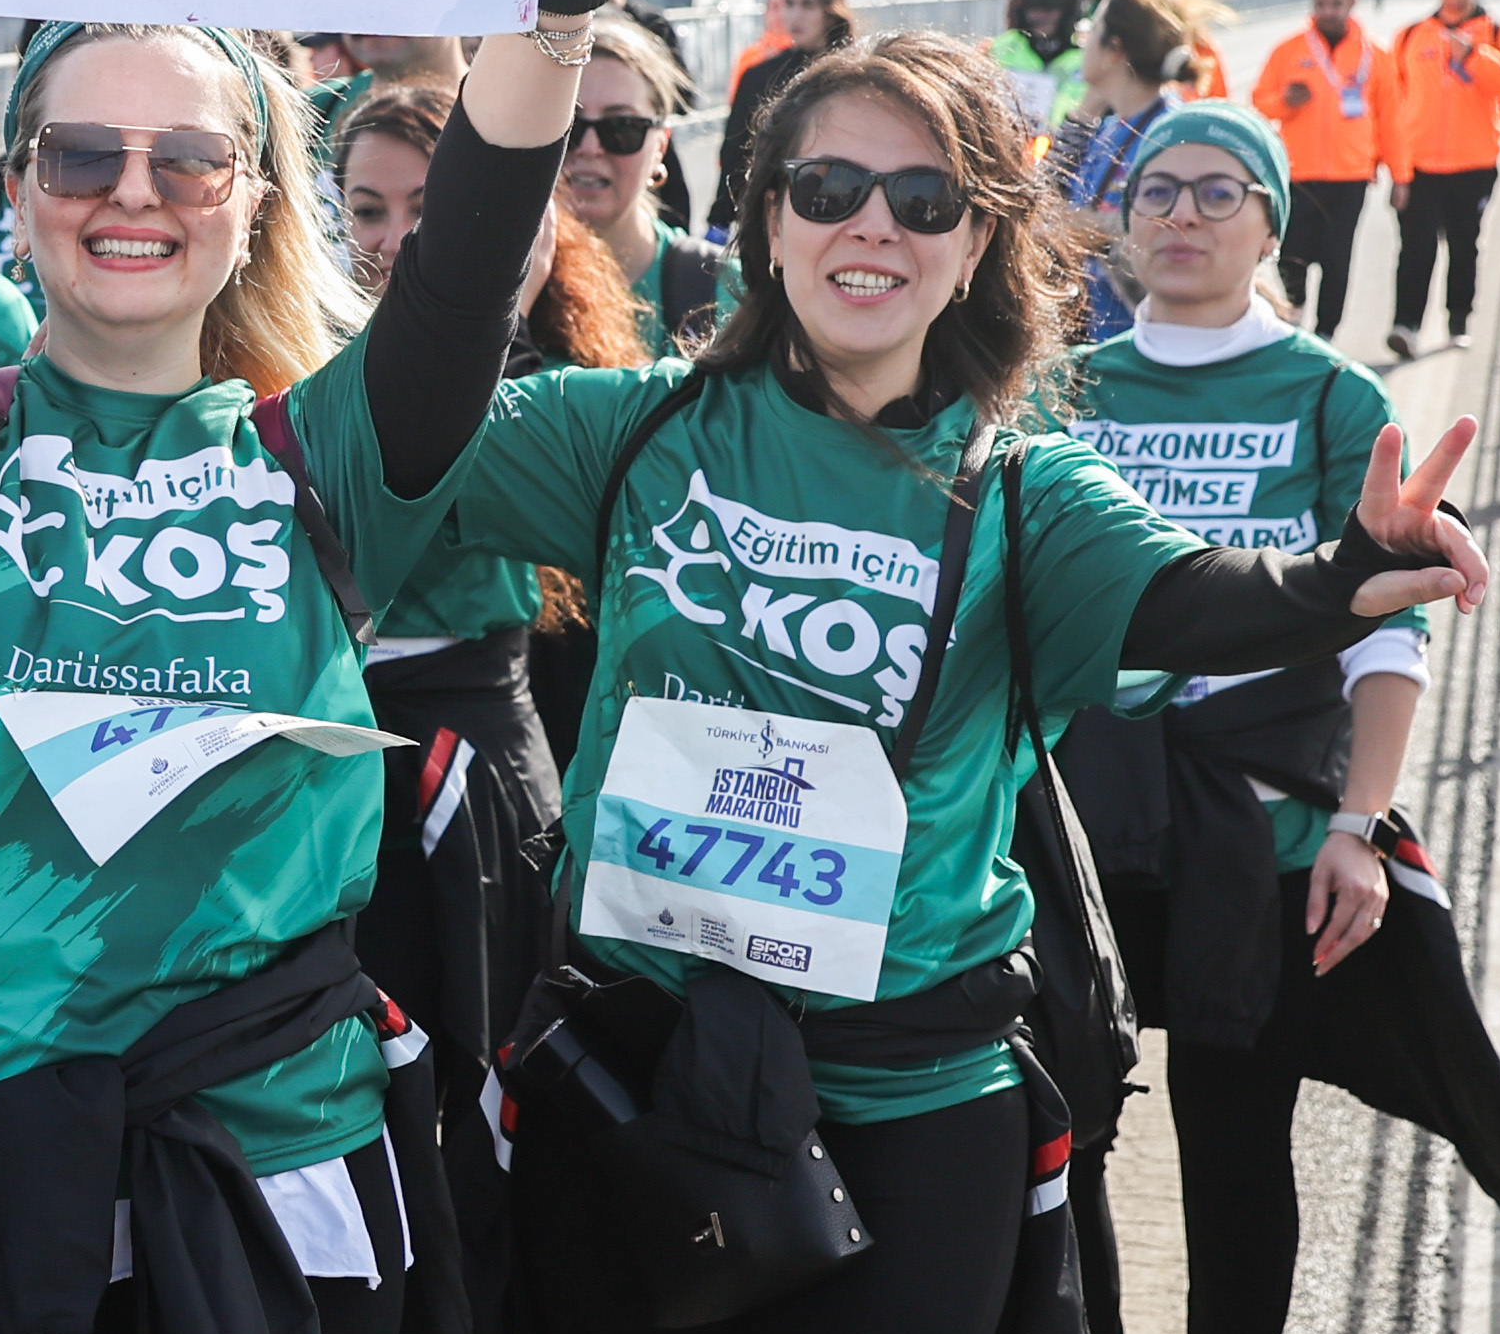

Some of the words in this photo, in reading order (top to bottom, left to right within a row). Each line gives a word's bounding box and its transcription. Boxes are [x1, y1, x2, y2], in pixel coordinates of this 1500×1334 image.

[1136, 431, 1285, 460] KONUSU
[164, 461, 236, 506] için
[729, 515, 839, 567] Eğitim
[851, 542, 921, 588] için
[84, 518, 290, 623] KOŞ
[706, 726, 758, 743] TÜRKİYE
[776, 737, 830, 754] BANKASI
[711, 767, 803, 806] İSTANBUL
[705, 793, 802, 829] MARATONU
[636, 818, 847, 906] 47743
[750, 949, 807, 971] İSTANBUL
[751, 937, 808, 961] SPOR
